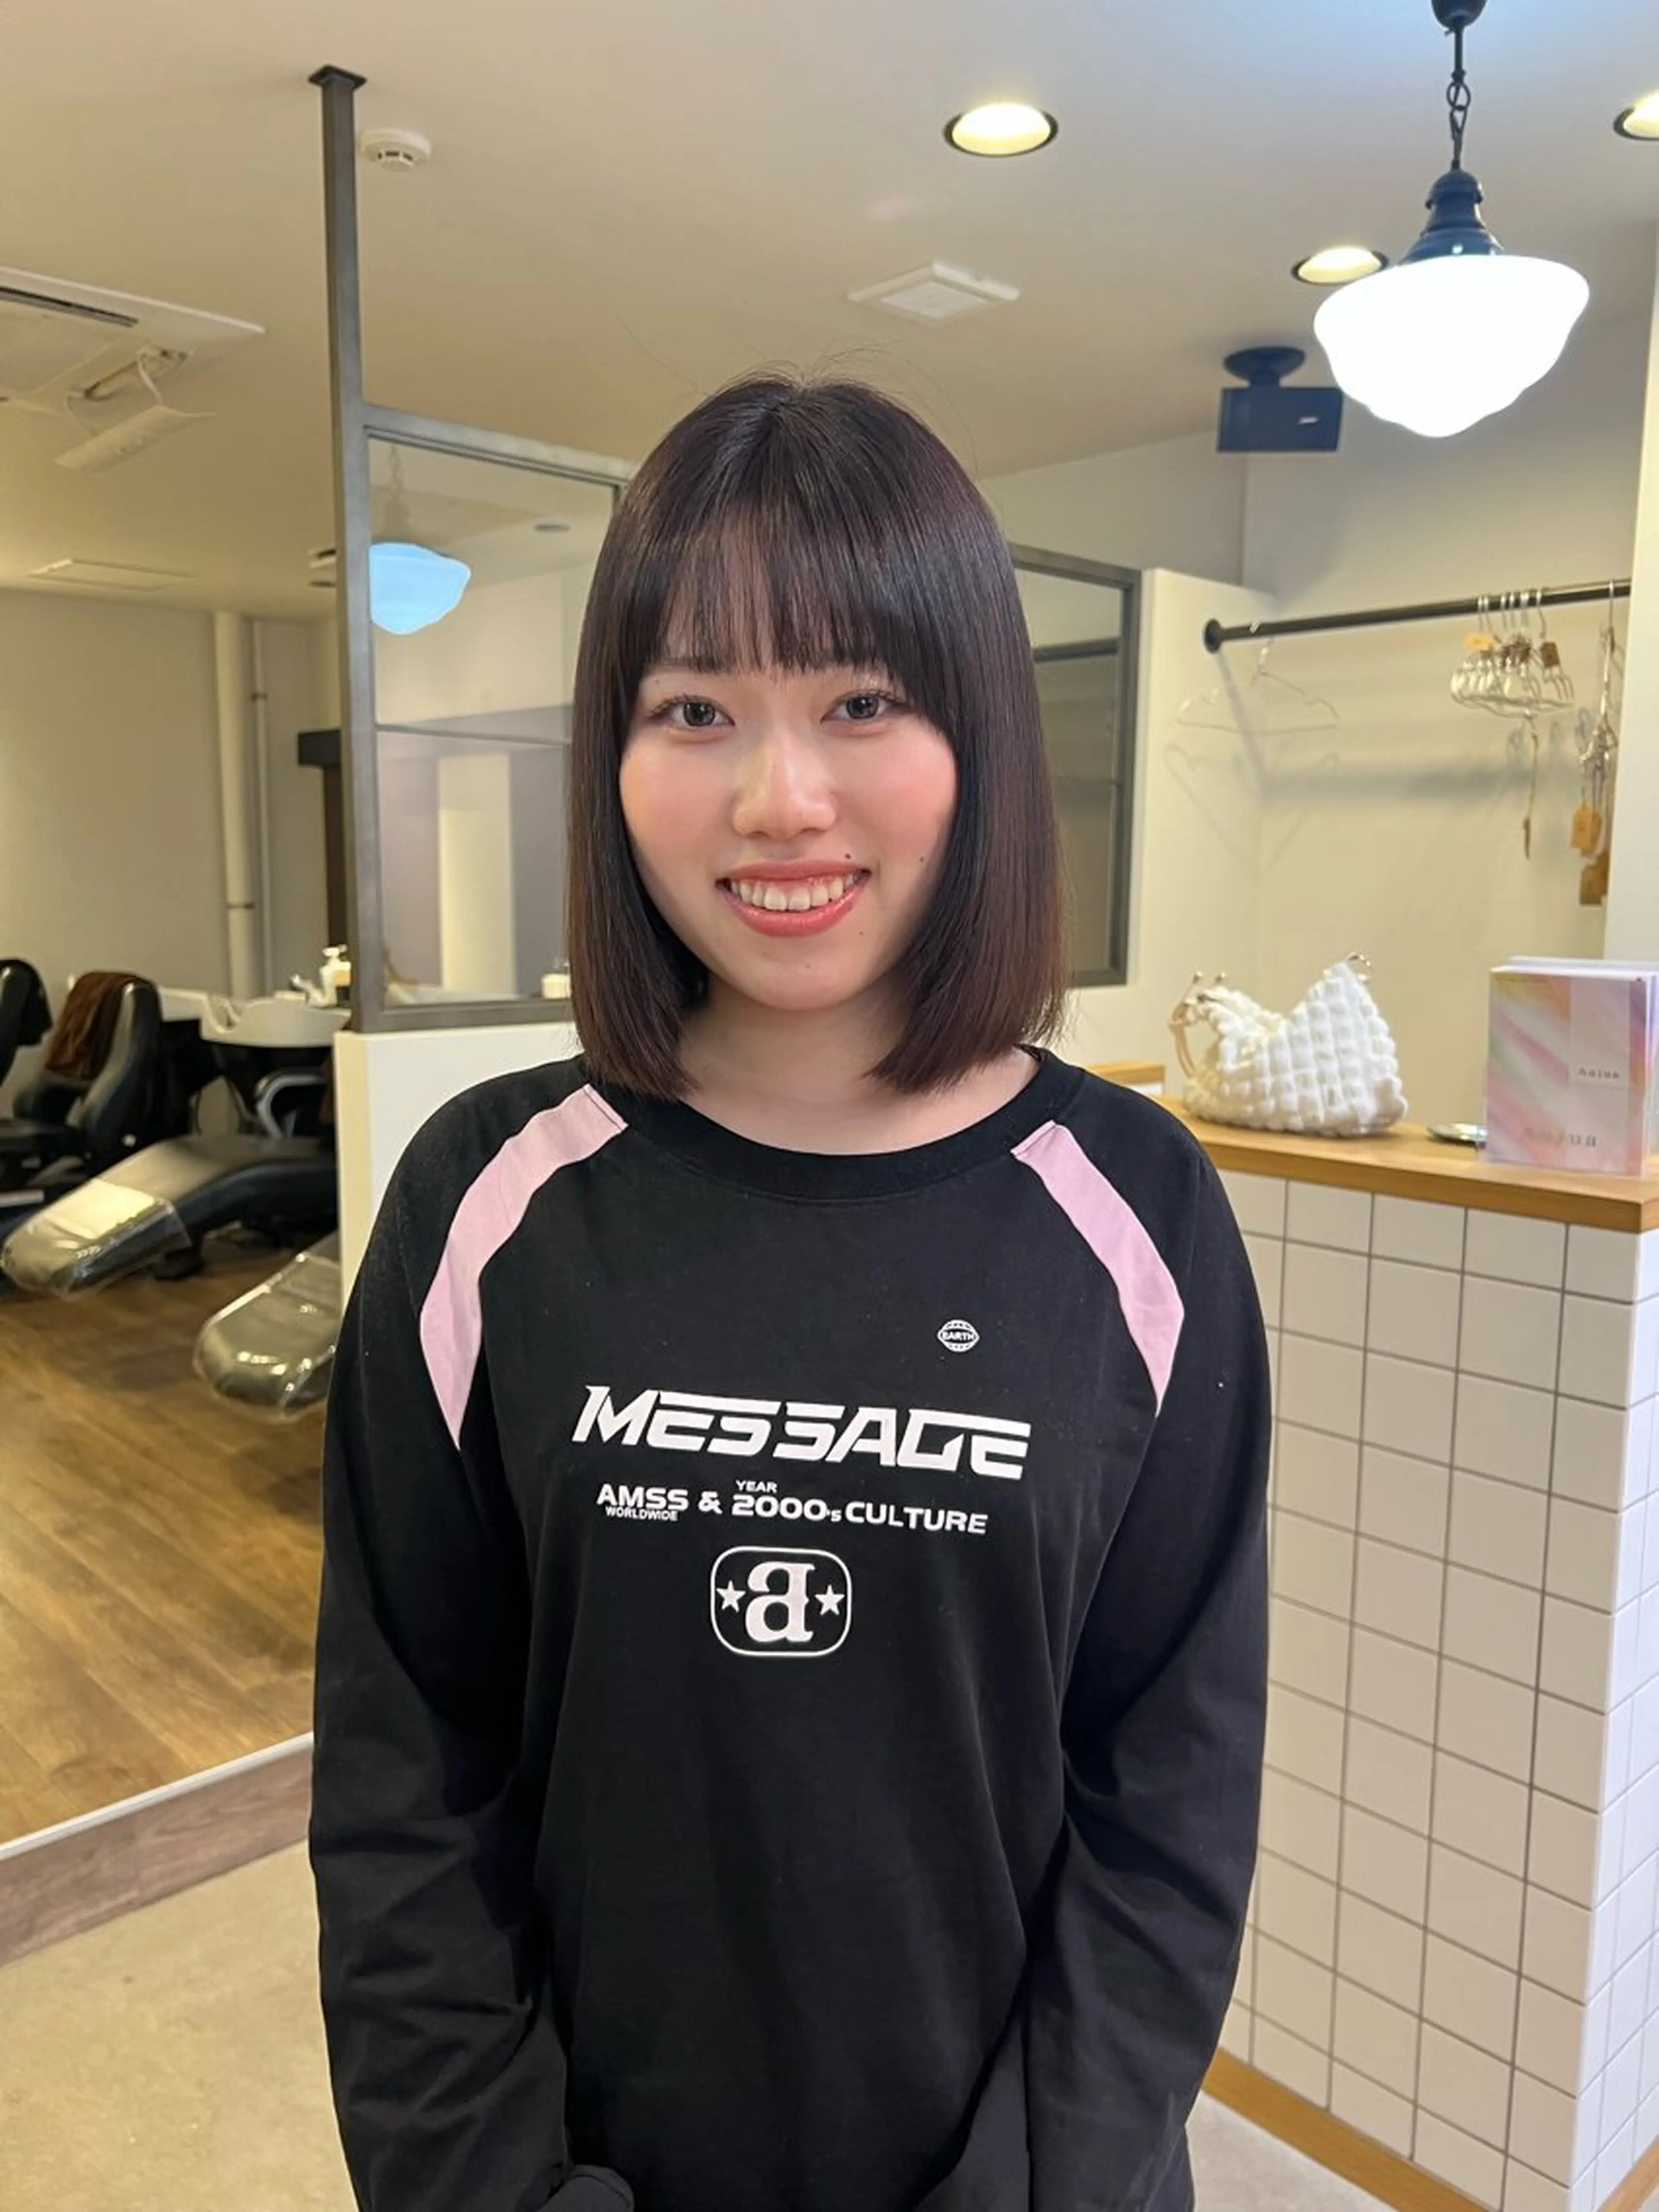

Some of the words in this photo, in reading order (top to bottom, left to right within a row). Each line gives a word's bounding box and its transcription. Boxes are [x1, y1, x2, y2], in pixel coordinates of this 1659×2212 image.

[941, 1331, 974, 1341] EARTH
[572, 1385, 1031, 1480] MESSAGE
[736, 1479, 777, 1494] YEAR
[597, 1484, 689, 1511] AMSS
[698, 1491, 723, 1514] &
[845, 1501, 988, 1535] CULTURE
[606, 1506, 679, 1522] WORLDWIDE
